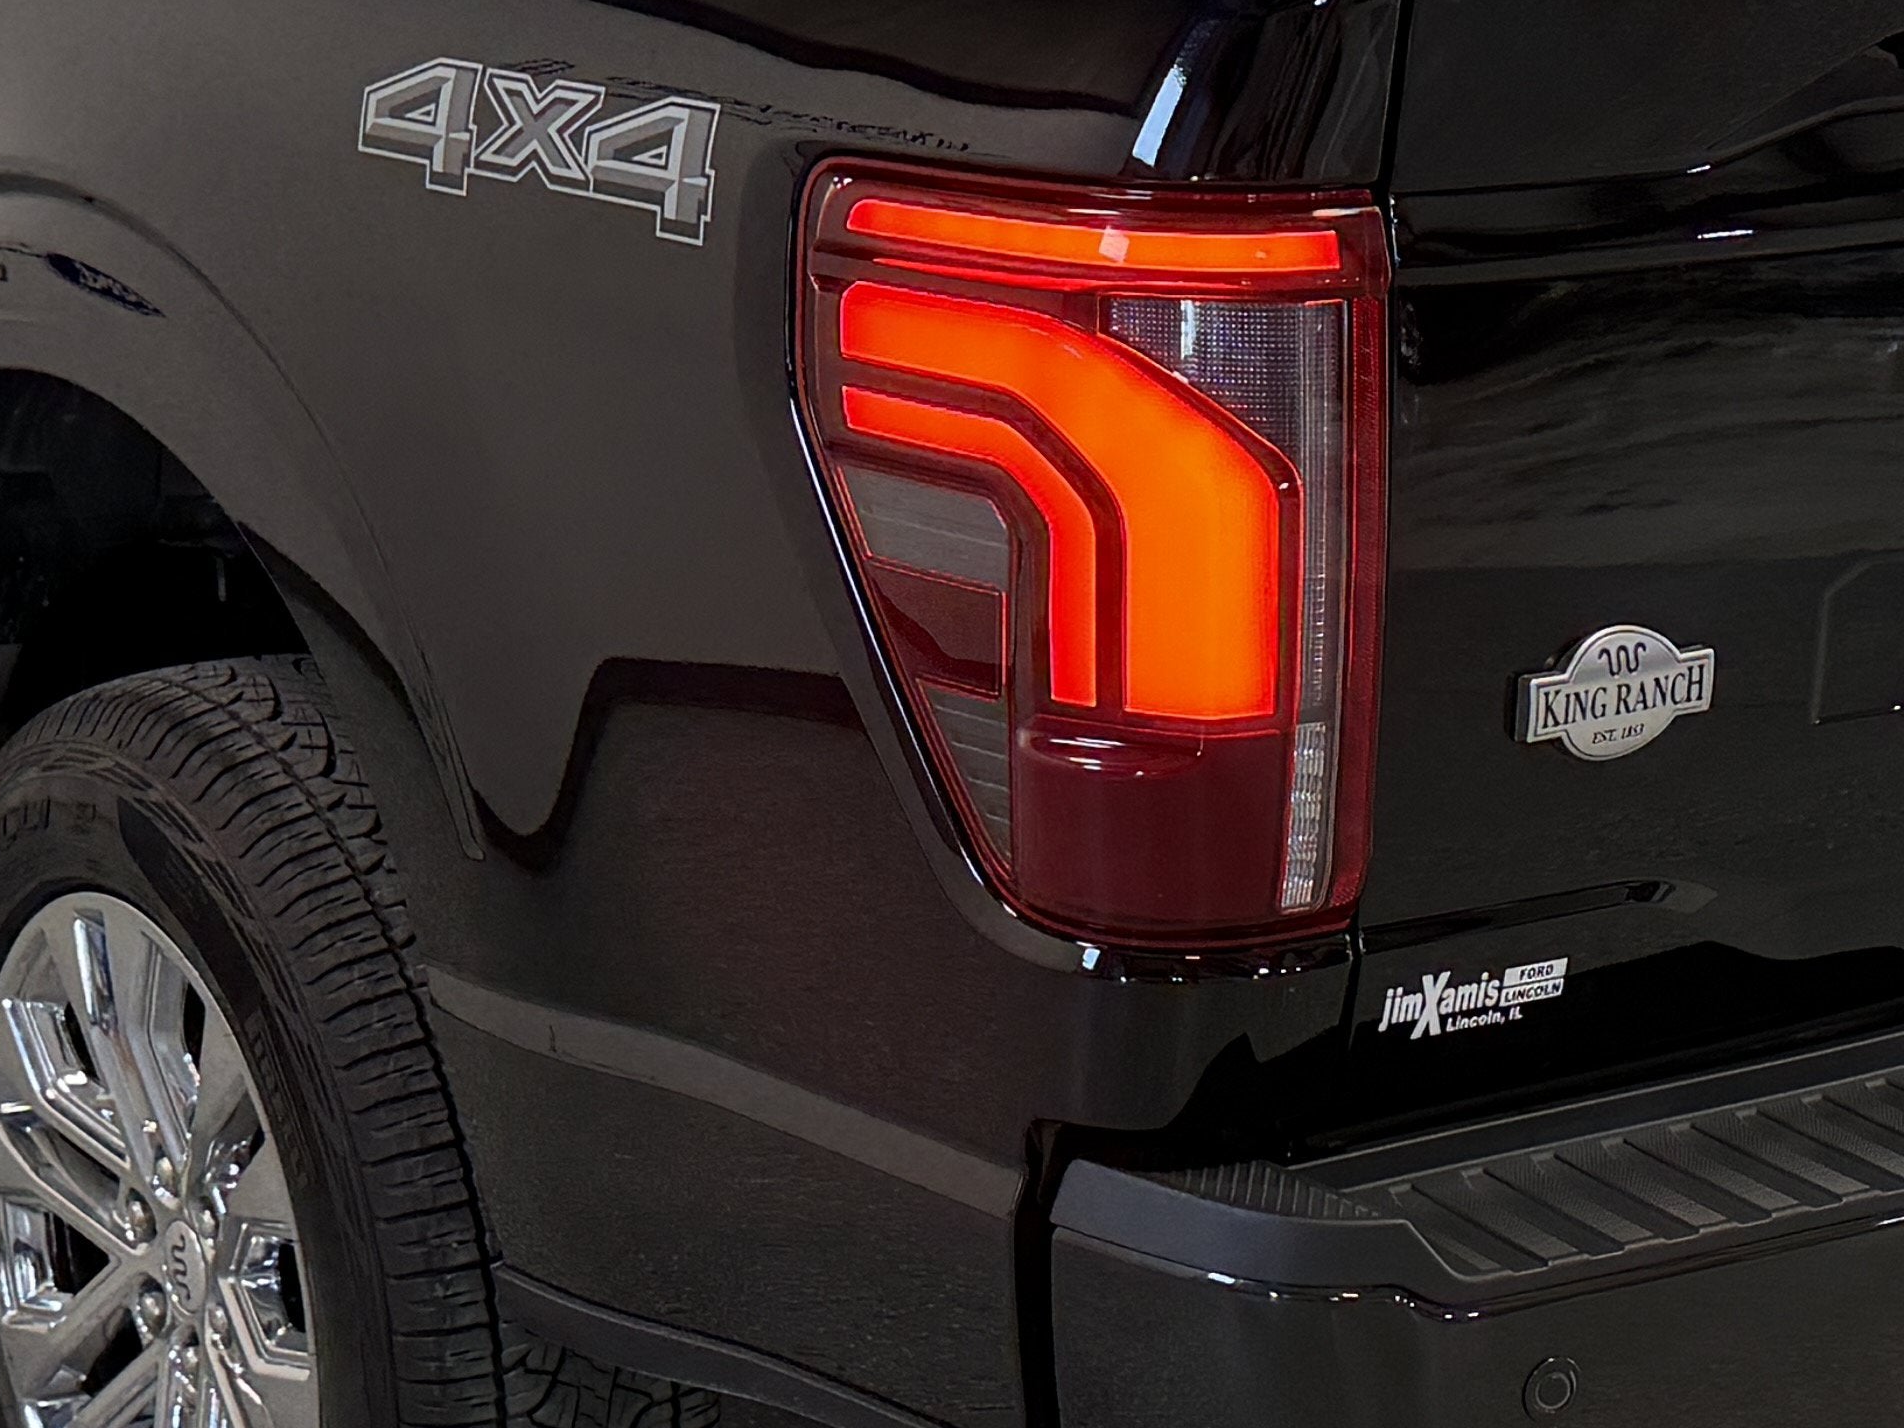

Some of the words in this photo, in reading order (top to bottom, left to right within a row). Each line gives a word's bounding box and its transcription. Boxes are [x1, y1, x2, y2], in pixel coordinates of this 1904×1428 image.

[1541, 686, 1607, 730] KING
[1614, 663, 1705, 716] RANCH
[1519, 963, 1553, 981] FORD
[1503, 980, 1562, 1003] LINCOLN
[1446, 1009, 1506, 1032] Lincoln,
[1509, 1005, 1523, 1020] IL
